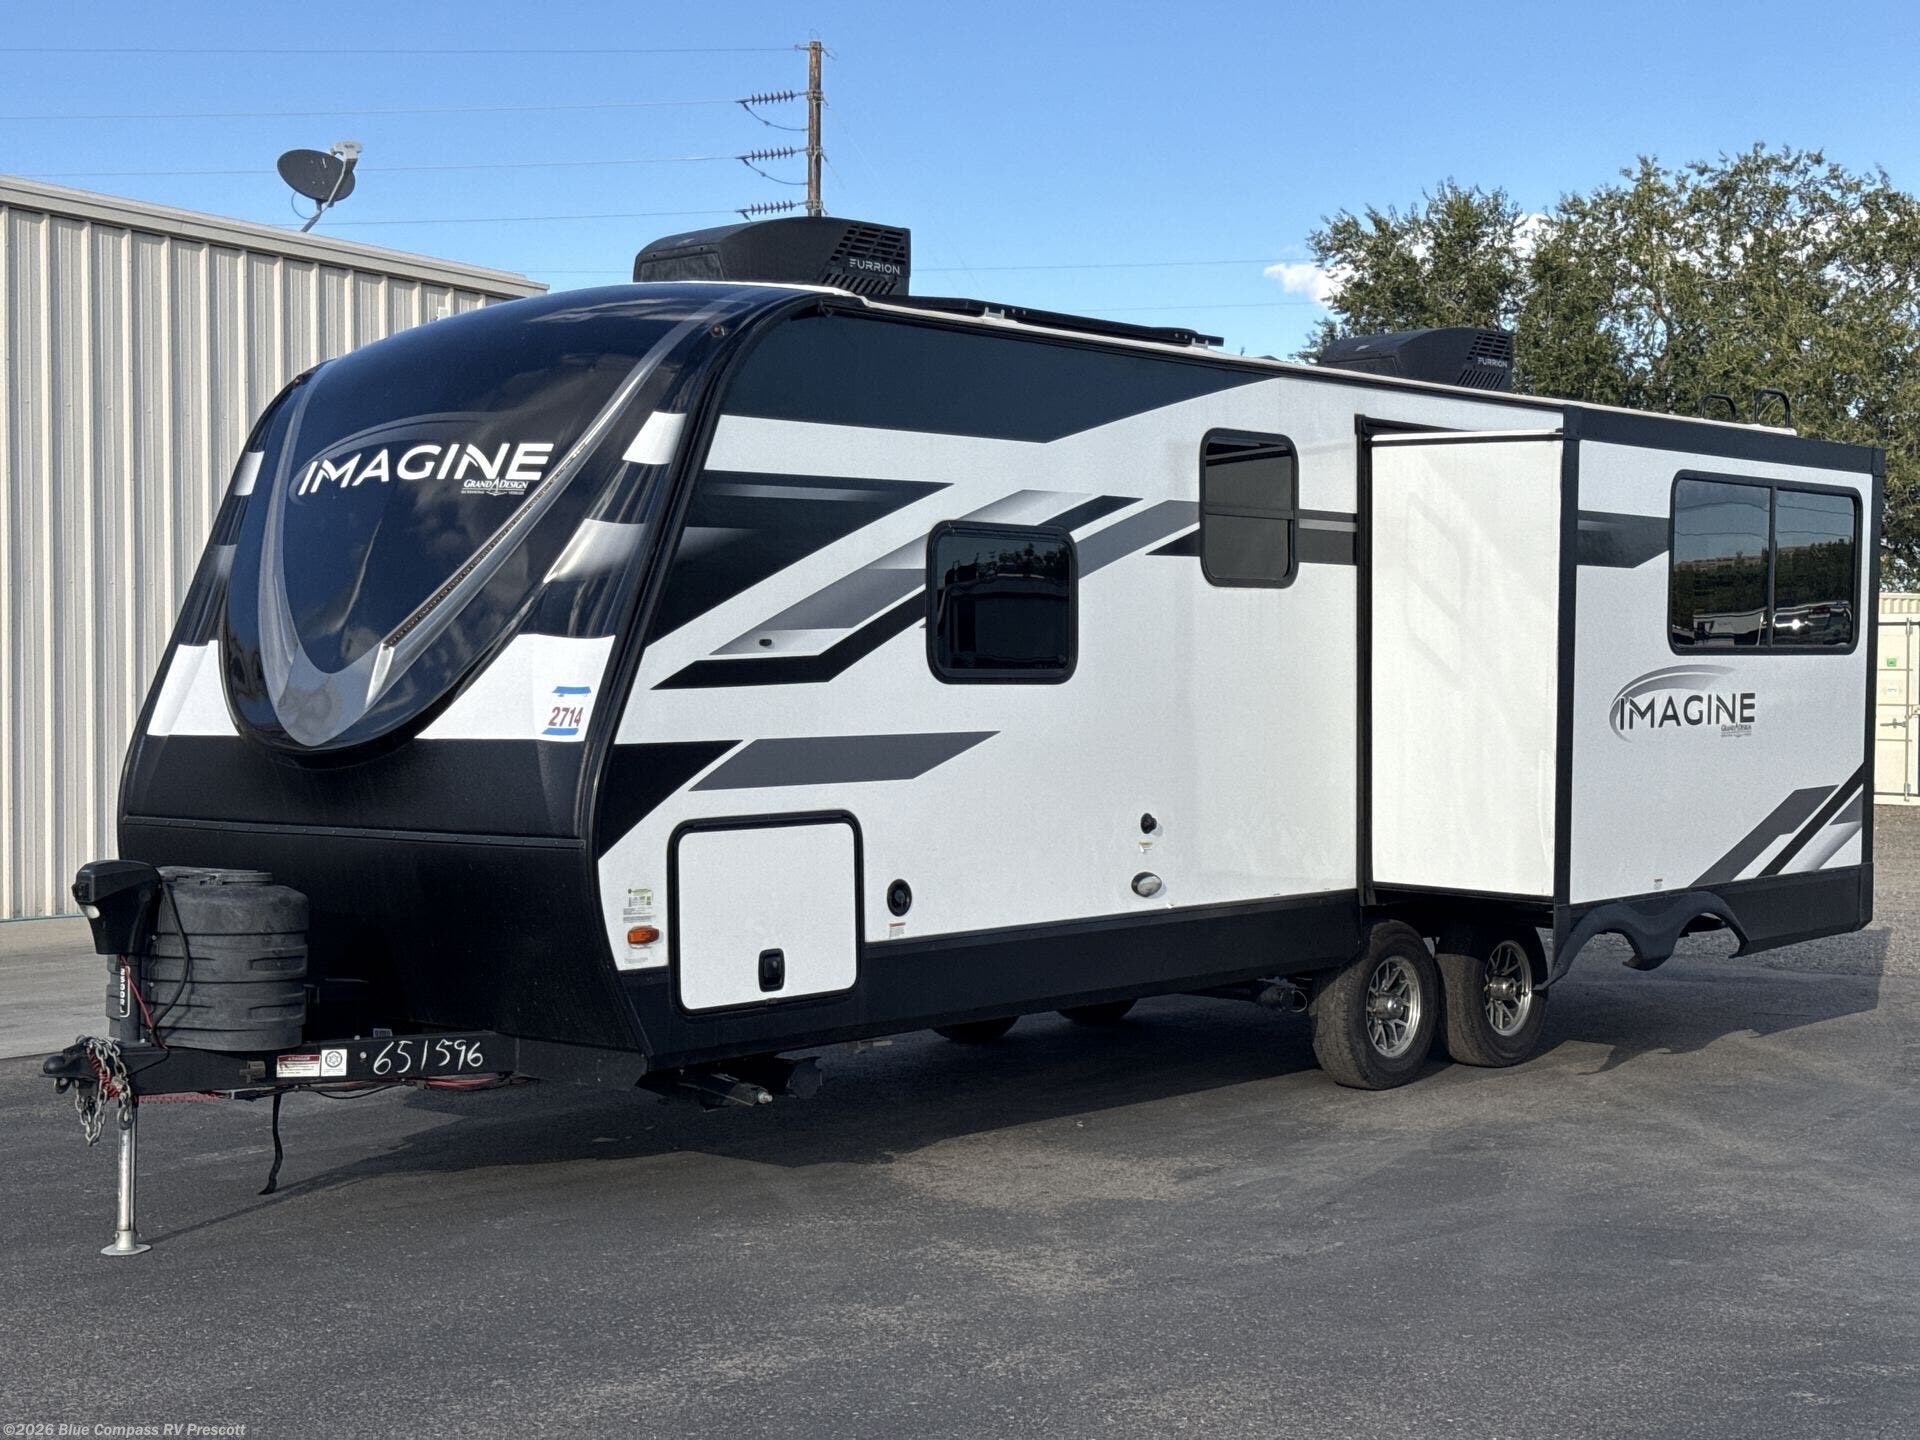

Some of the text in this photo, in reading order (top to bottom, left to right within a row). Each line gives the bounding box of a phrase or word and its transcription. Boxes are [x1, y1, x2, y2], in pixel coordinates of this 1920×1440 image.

[849, 258, 900, 275] FURRION
[1477, 357, 1508, 368] FURRION
[298, 443, 554, 496] IMAGINE
[463, 479, 529, 489] GRAND DESIGN
[548, 706, 584, 727] 2714
[1619, 693, 1756, 731] IMAGINE
[373, 1038, 484, 1075] 651596
